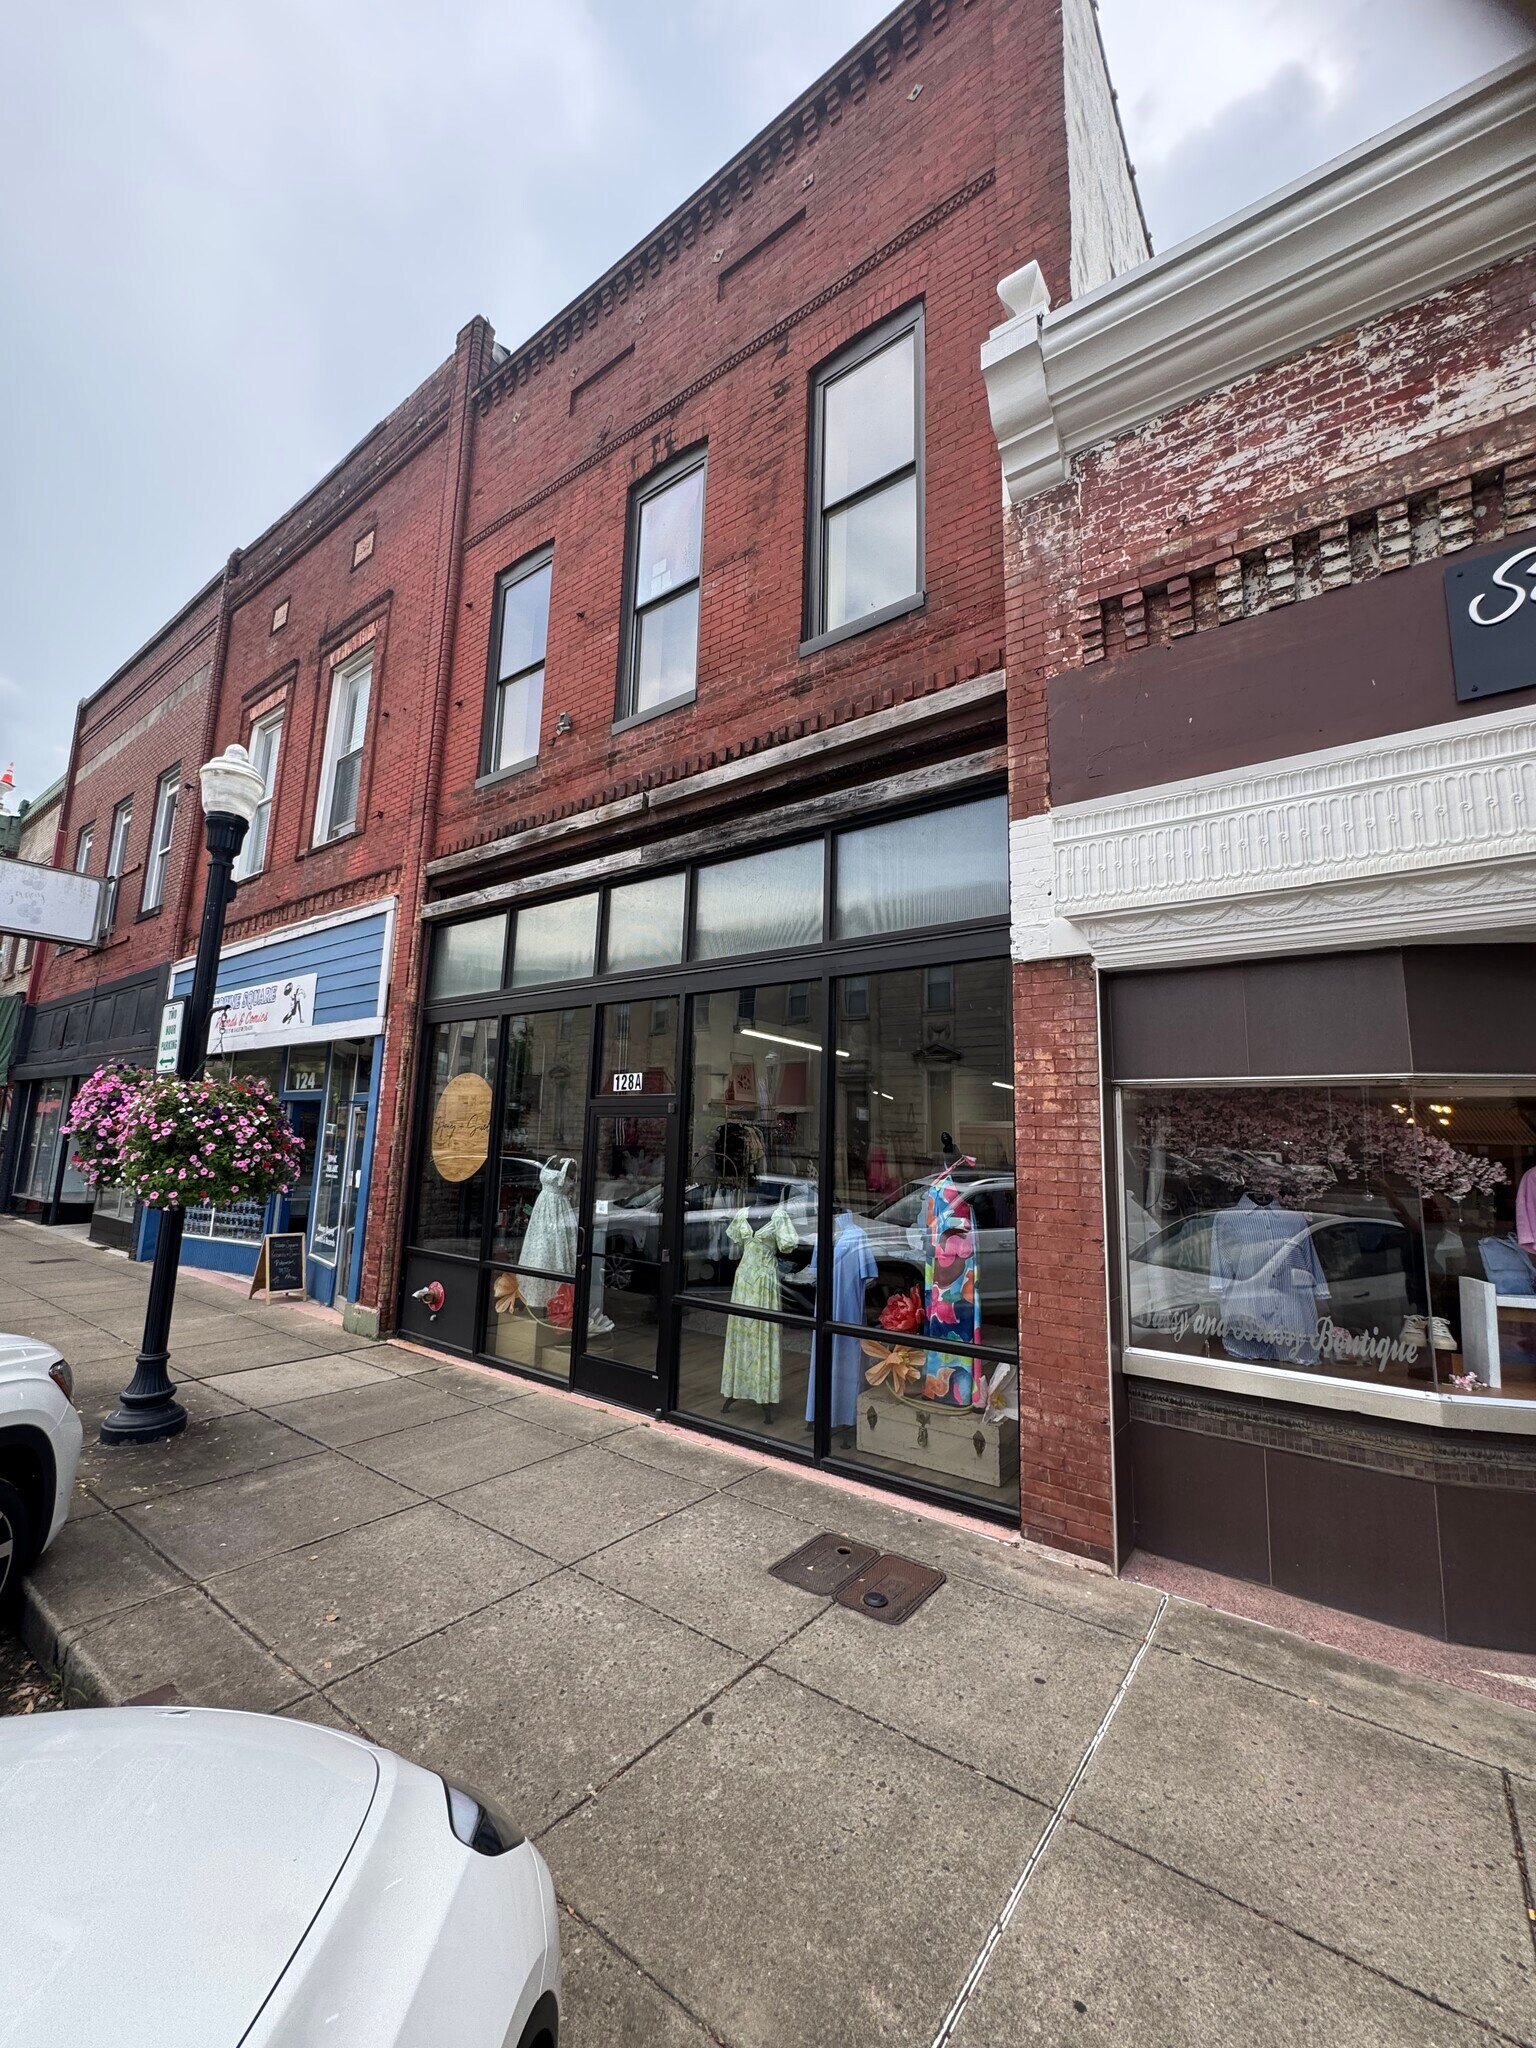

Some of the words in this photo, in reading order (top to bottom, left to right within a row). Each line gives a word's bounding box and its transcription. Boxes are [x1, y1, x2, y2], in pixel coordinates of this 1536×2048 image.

[242, 985, 278, 1010] SQUARE
[168, 1009, 178, 1020] TWO
[245, 1011, 268, 1025] Comics
[165, 1024, 177, 1036] HOUR
[160, 1039, 178, 1051] PARKING
[295, 1072, 316, 1090] 124
[615, 1073, 642, 1091] 128A
[1193, 1312, 1229, 1337] and
[1310, 1316, 1418, 1372] Boutique
